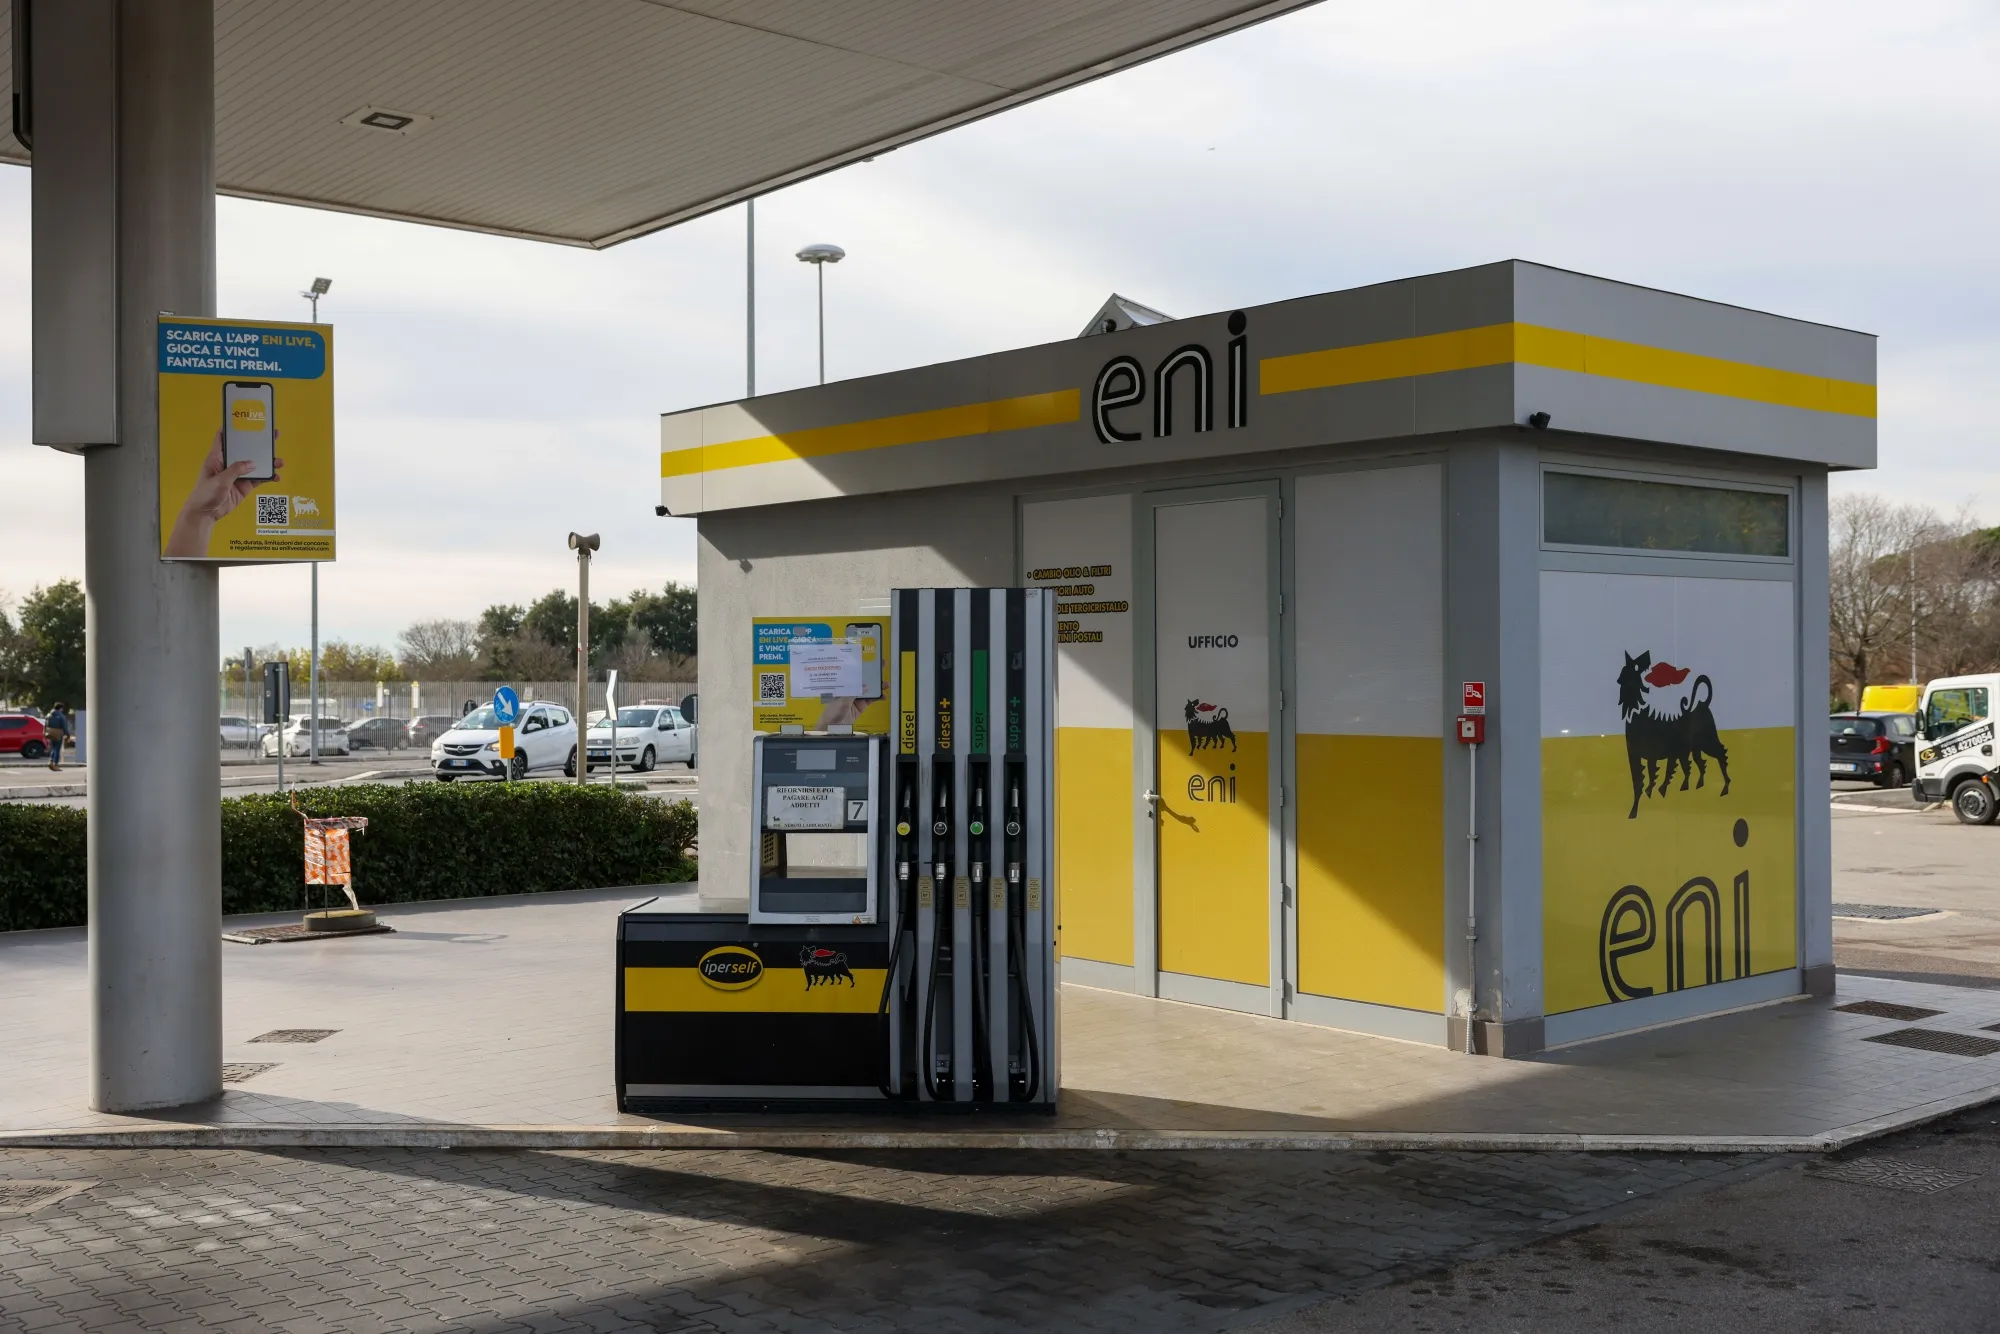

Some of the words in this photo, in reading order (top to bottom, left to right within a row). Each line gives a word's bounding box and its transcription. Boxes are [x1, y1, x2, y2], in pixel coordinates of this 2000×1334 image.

[166, 329, 223, 343] SCARICA
[262, 335, 283, 345] ENI
[285, 335, 316, 348] LIVE,
[166, 343, 210, 356] GIOCA
[213, 345, 221, 356] E
[224, 345, 259, 357] VINCI
[166, 356, 236, 370] FANTASTICI
[240, 360, 282, 372] PREMI.
[1092, 310, 1247, 444] eni
[1033, 568, 1062, 580] CAMBIO
[1063, 567, 1082, 578] OLIO
[1082, 566, 1090, 577] &
[1091, 565, 1112, 577] FILTRI
[1072, 584, 1094, 596] AUTO
[1070, 601, 1128, 614] TERGICRISTALLO
[758, 628, 791, 636] SCARICA
[1072, 631, 1102, 642] POSTALI
[1188, 634, 1239, 648] UFFICIO
[902, 710, 914, 749] diesel
[938, 711, 951, 749] diesel
[974, 711, 987, 749] super
[1010, 710, 1022, 749] super
[1188, 763, 1236, 803] eni
[852, 802, 864, 820] 7
[1599, 818, 1750, 1004] eni
[704, 959, 758, 976] iperself
